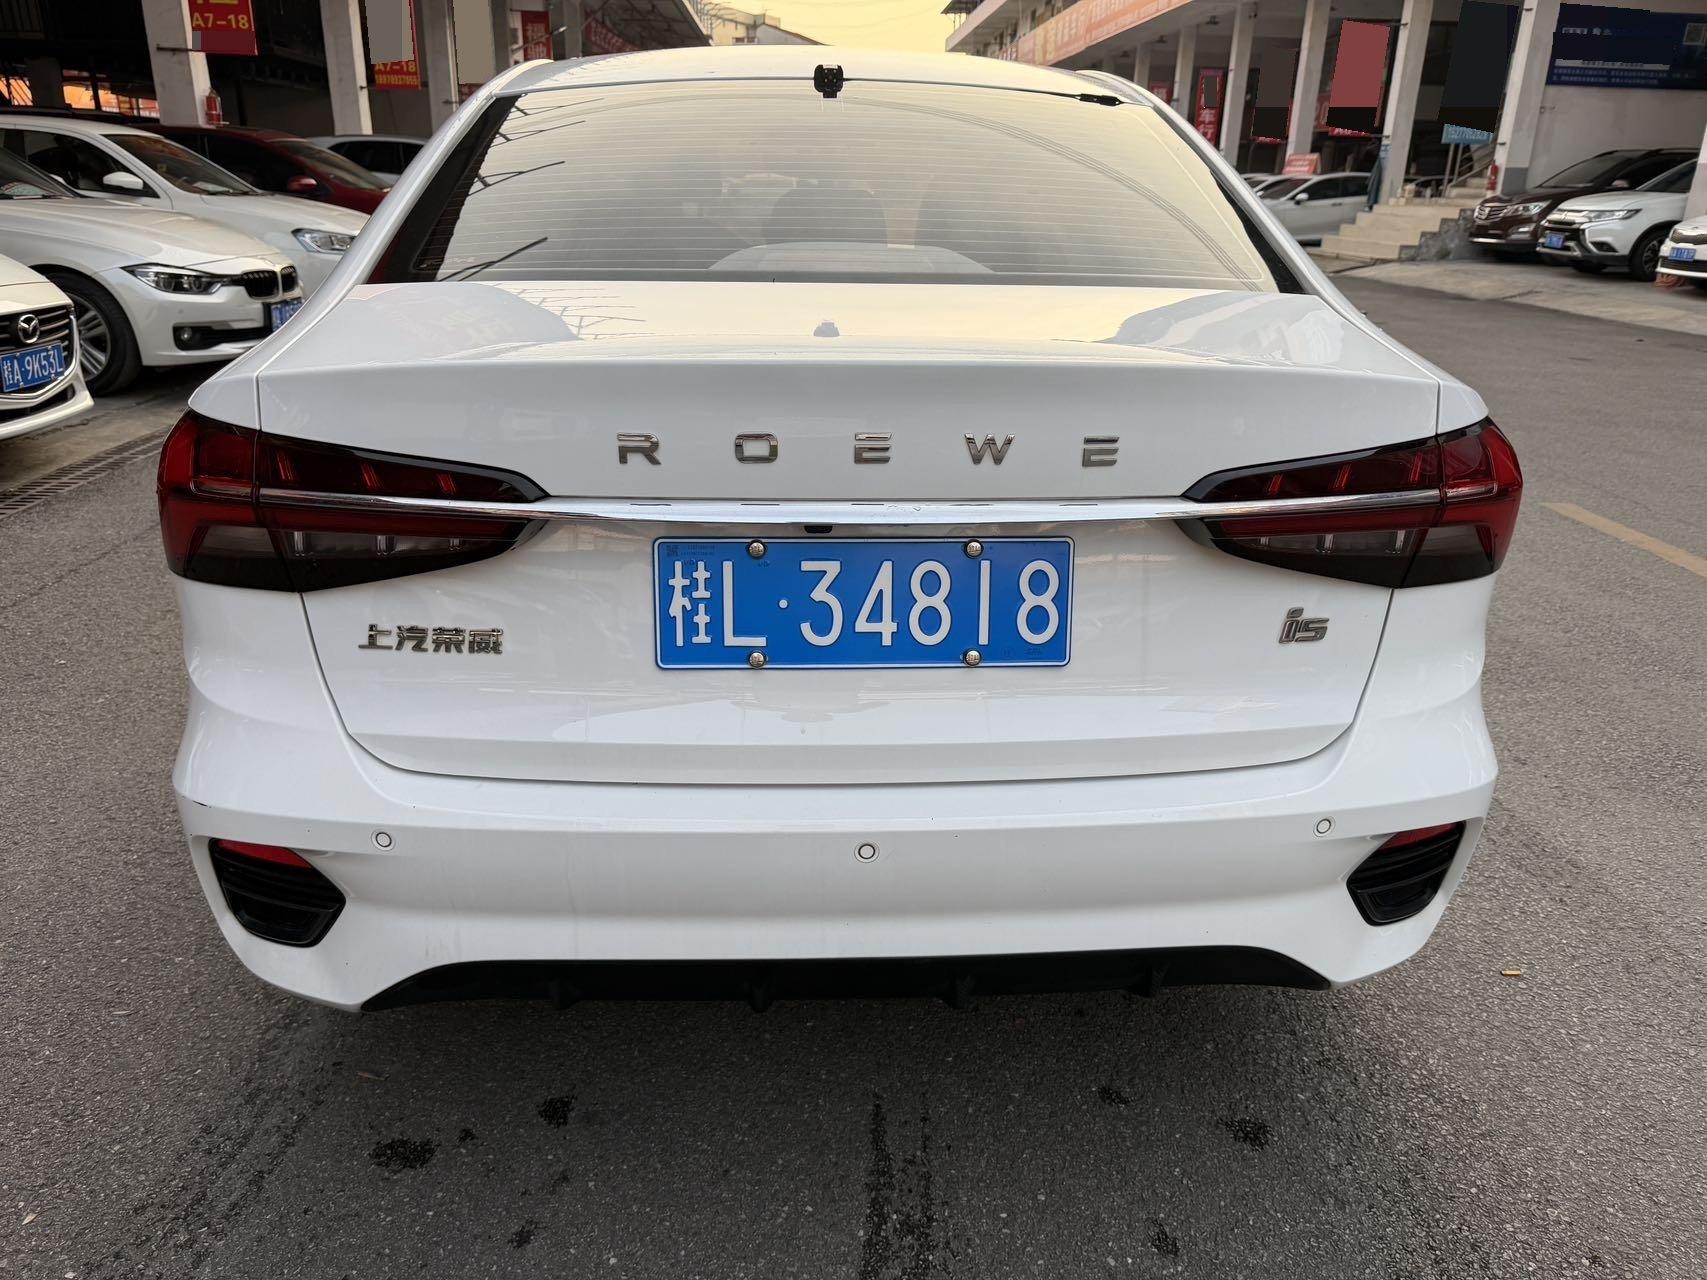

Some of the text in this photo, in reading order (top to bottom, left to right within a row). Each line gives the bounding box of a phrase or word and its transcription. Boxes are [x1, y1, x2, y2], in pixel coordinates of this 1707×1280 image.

[192, 12, 249, 29] A7-18
[617, 432, 1120, 468] ROEWE
[668, 560, 1060, 647] 桂L·34818
[358, 623, 504, 655] 上汽荣威
